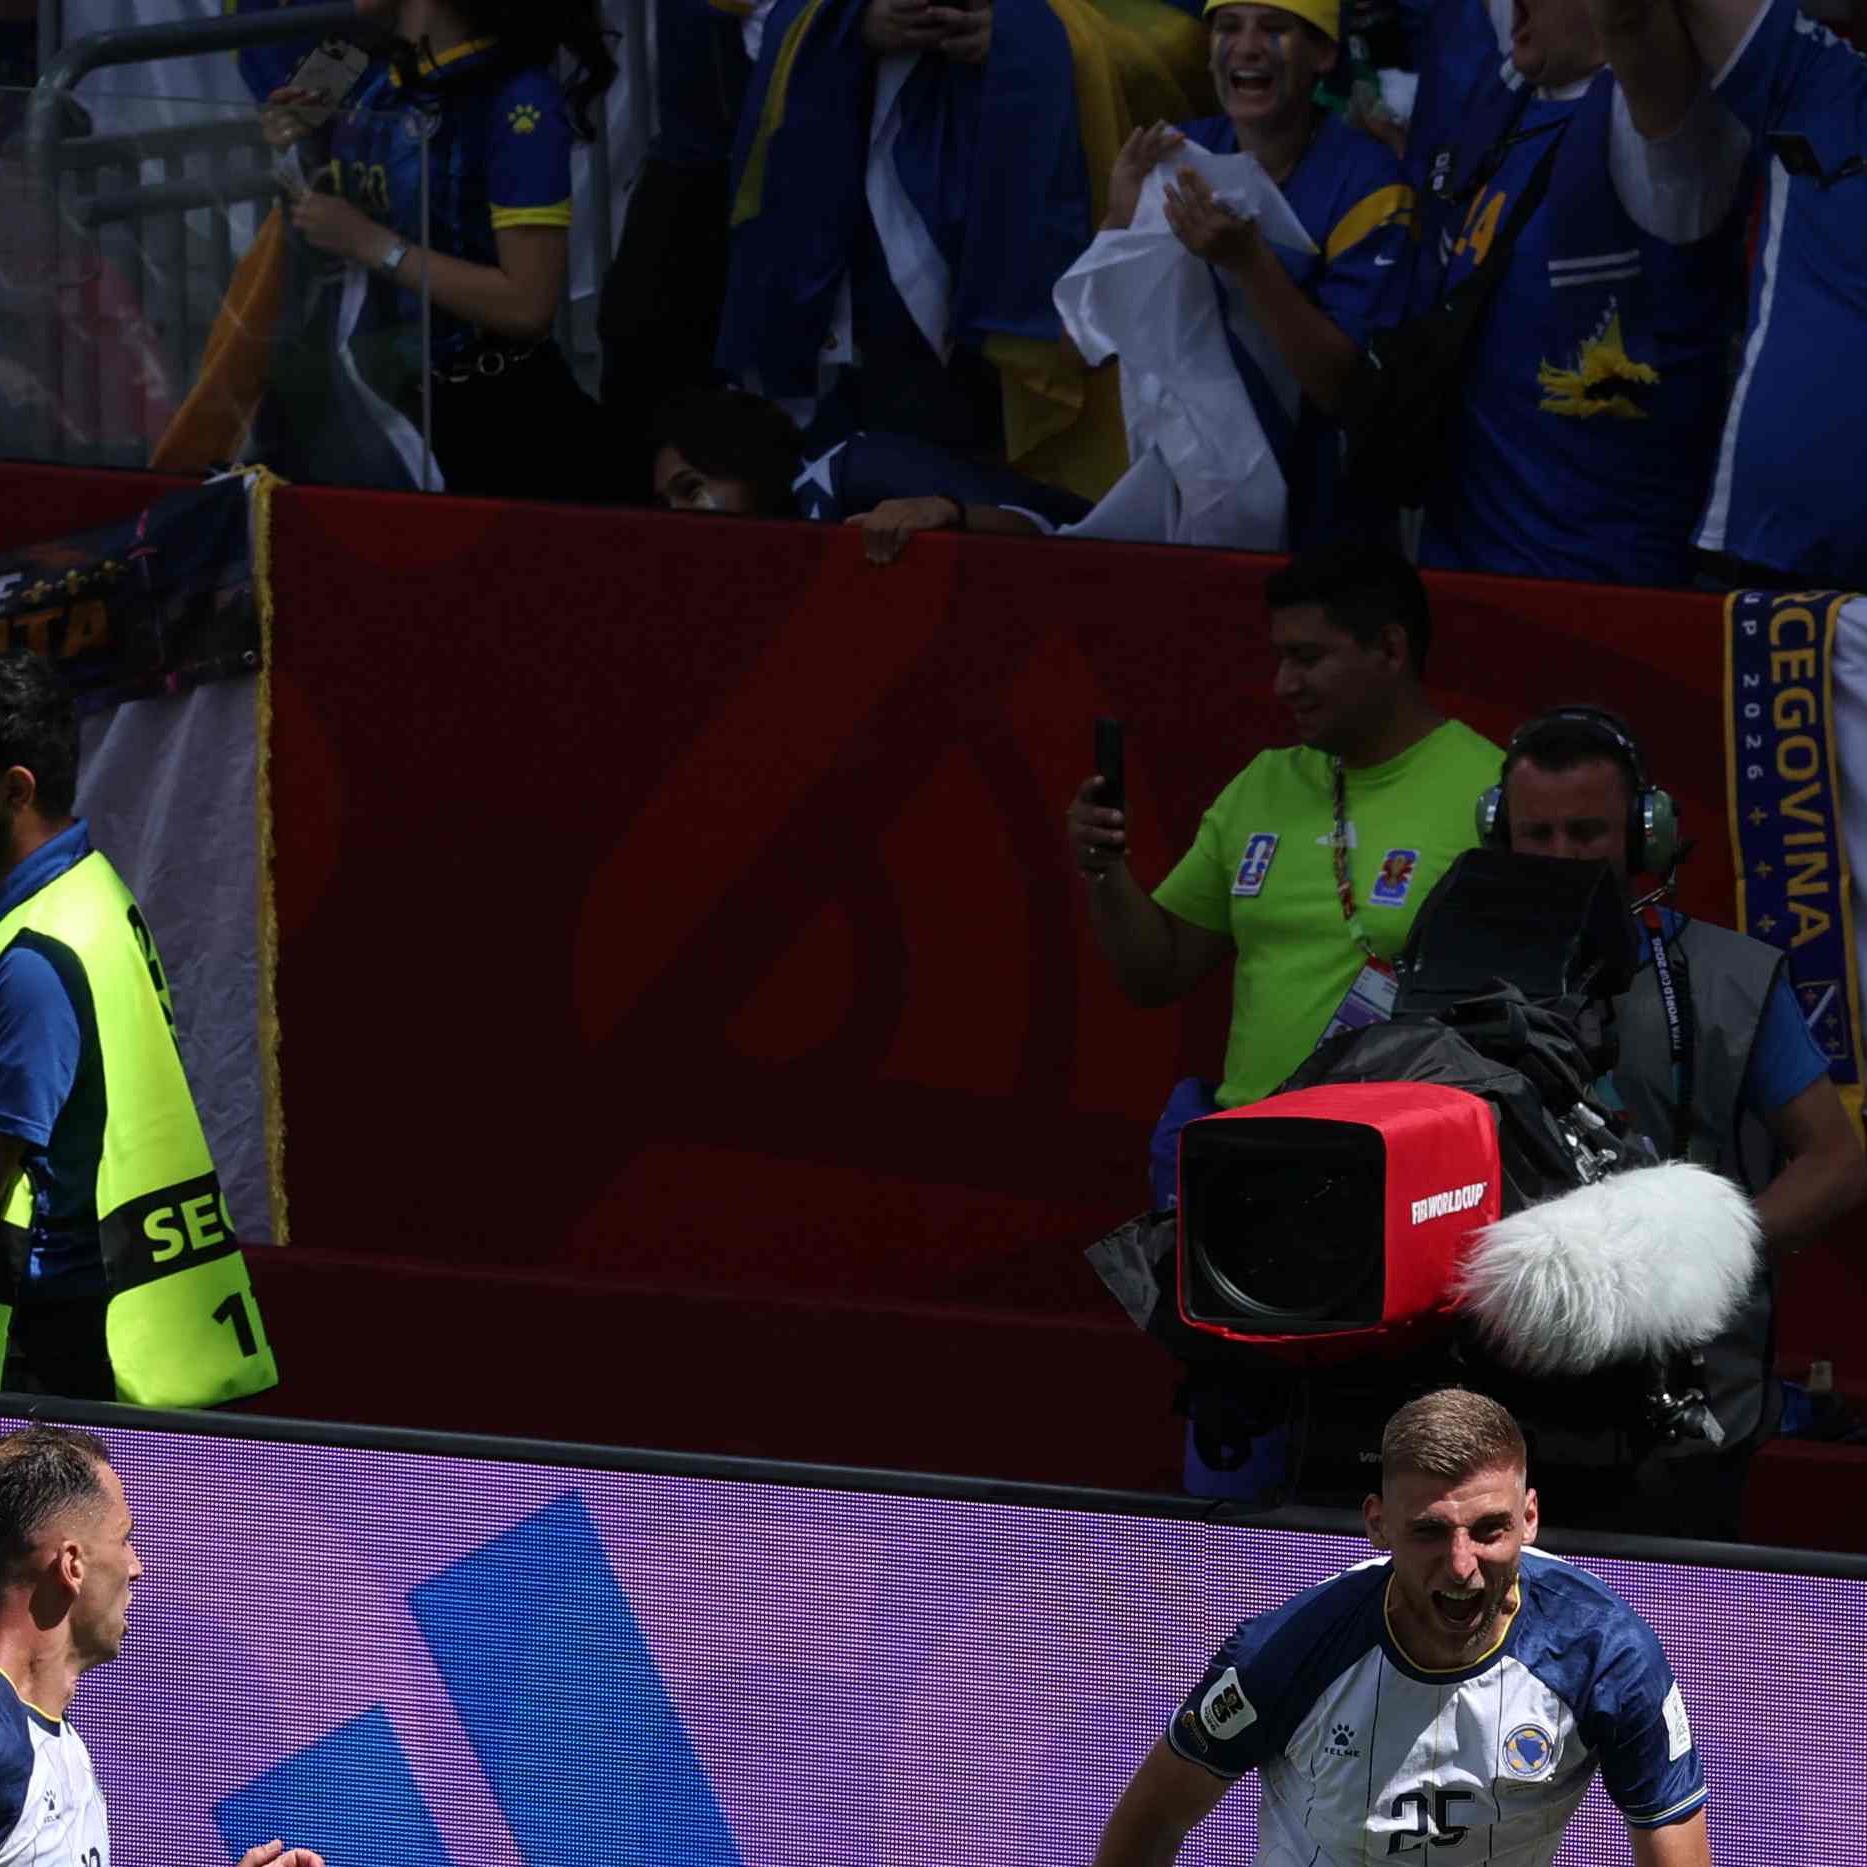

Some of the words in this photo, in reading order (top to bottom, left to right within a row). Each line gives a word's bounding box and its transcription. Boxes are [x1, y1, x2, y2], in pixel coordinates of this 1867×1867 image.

[1742, 673, 1765, 780] 2026
[1768, 588, 1832, 948] CEGOVINA
[1428, 1188, 1462, 1219] WORLD
[1461, 1182, 1485, 1210] CUP
[1386, 1789, 1475, 1857] 25
